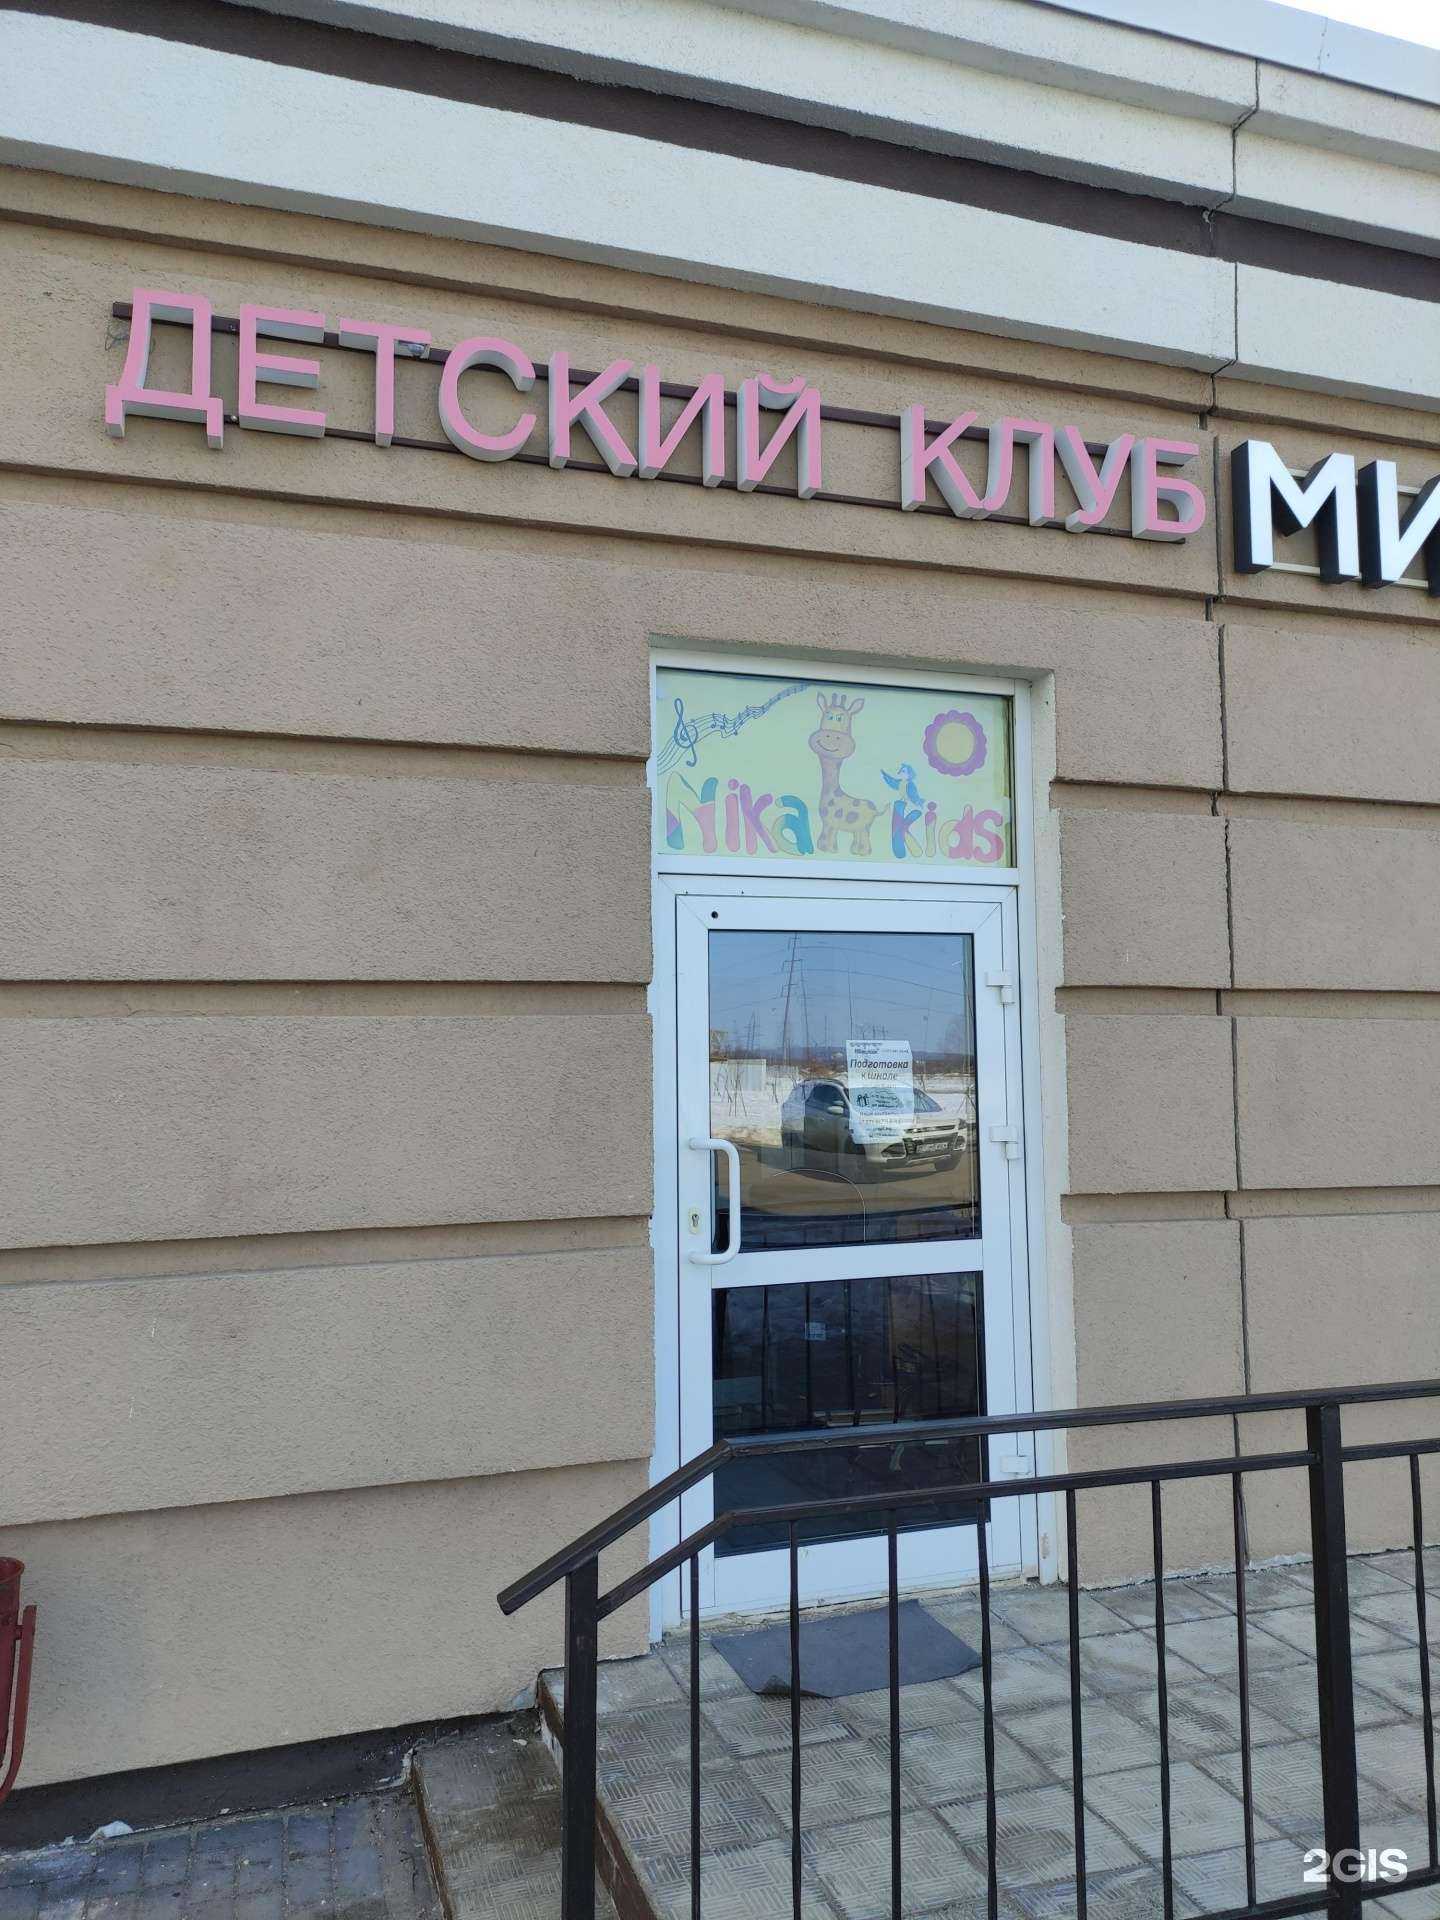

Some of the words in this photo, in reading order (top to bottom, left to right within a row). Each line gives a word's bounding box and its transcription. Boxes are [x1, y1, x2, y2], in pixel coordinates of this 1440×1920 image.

[105, 288, 822, 498] ДЕТСКИЙ
[901, 405, 1206, 541] КЛУБ
[850, 1059, 909, 1069] Подготовка
